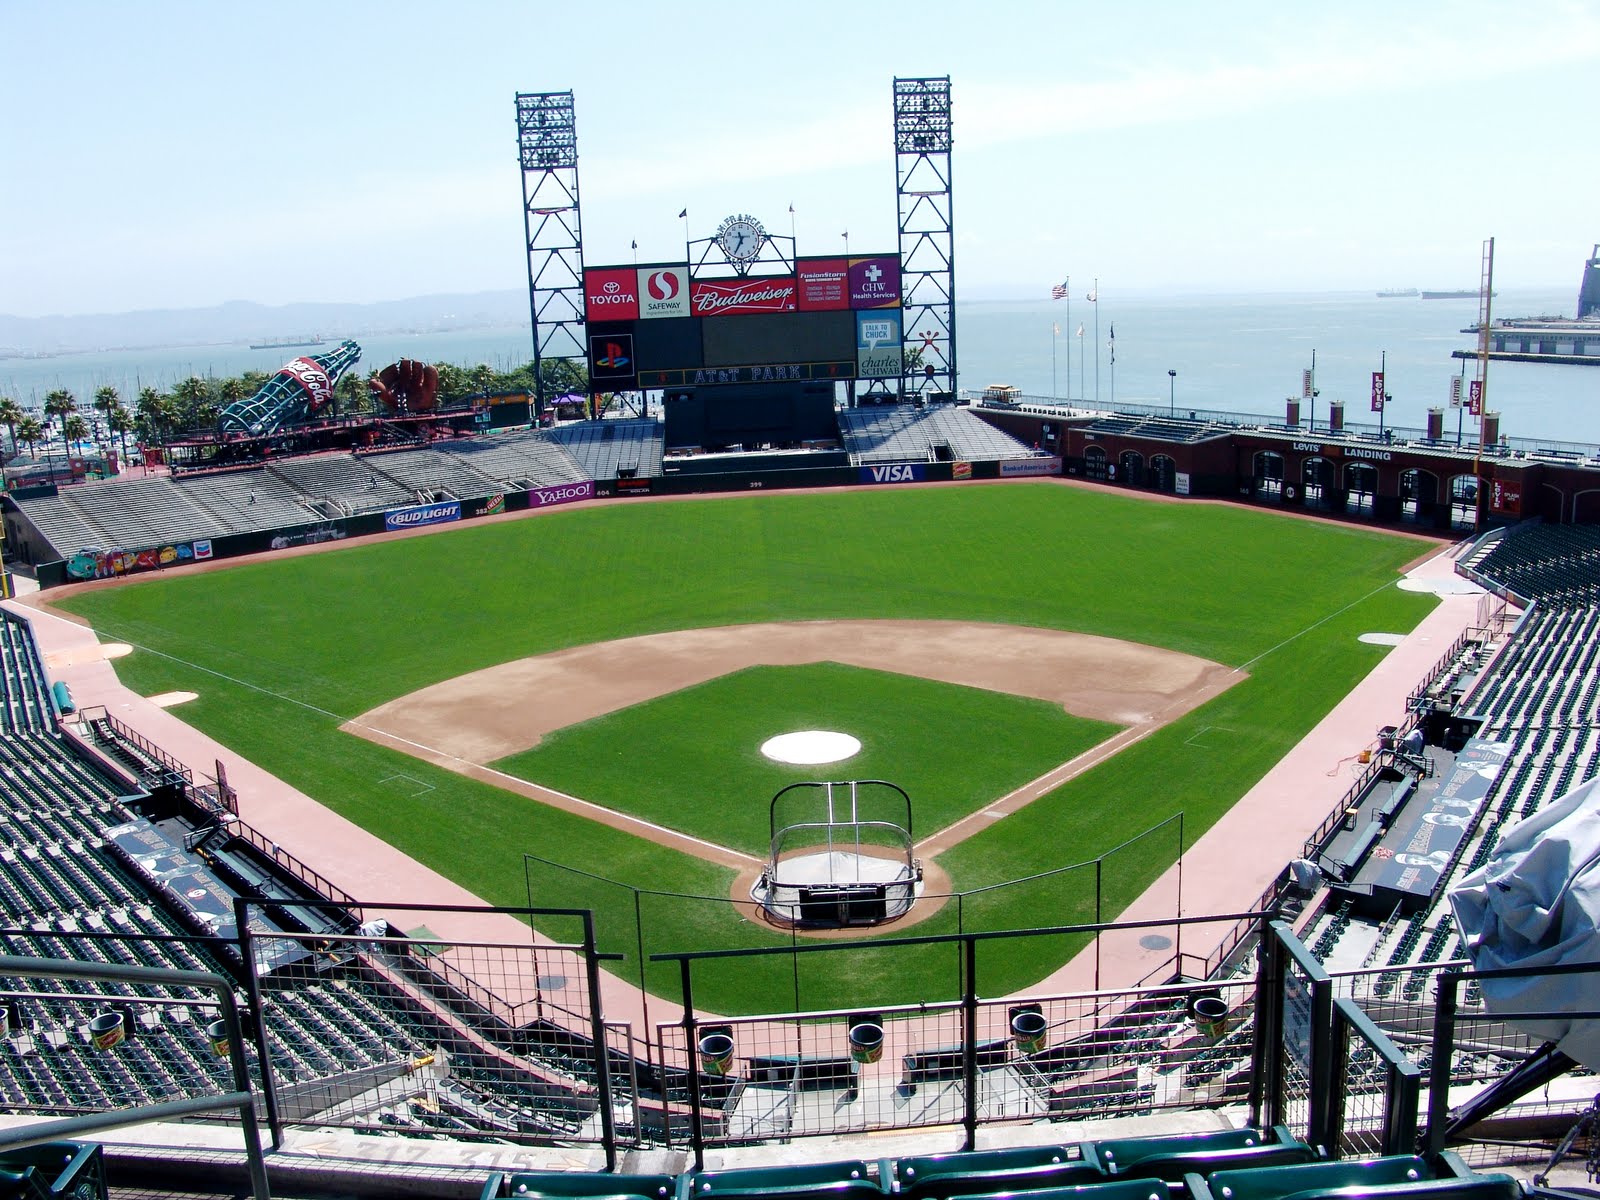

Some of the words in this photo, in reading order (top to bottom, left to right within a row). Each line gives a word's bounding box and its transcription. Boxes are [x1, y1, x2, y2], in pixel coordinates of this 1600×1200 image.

[800, 271, 847, 279] FusionStorm
[862, 282, 886, 292] CHW
[590, 294, 635, 305] TOYOTA
[692, 285, 794, 311] Budweiser
[872, 291, 896, 299] Services
[647, 302, 681, 310] SAFEWAY
[865, 331, 888, 339] CHUCK
[861, 355, 899, 368] charles
[694, 368, 739, 383] AT&T
[751, 365, 800, 381] PARK
[861, 367, 900, 376] SCHWAB
[300, 369, 332, 404] Cola
[1344, 447, 1391, 460] LANDING
[872, 465, 914, 482] VISA
[535, 483, 591, 505] YAHOO!
[395, 511, 422, 524] BUD
[420, 505, 459, 520] LIGHT
